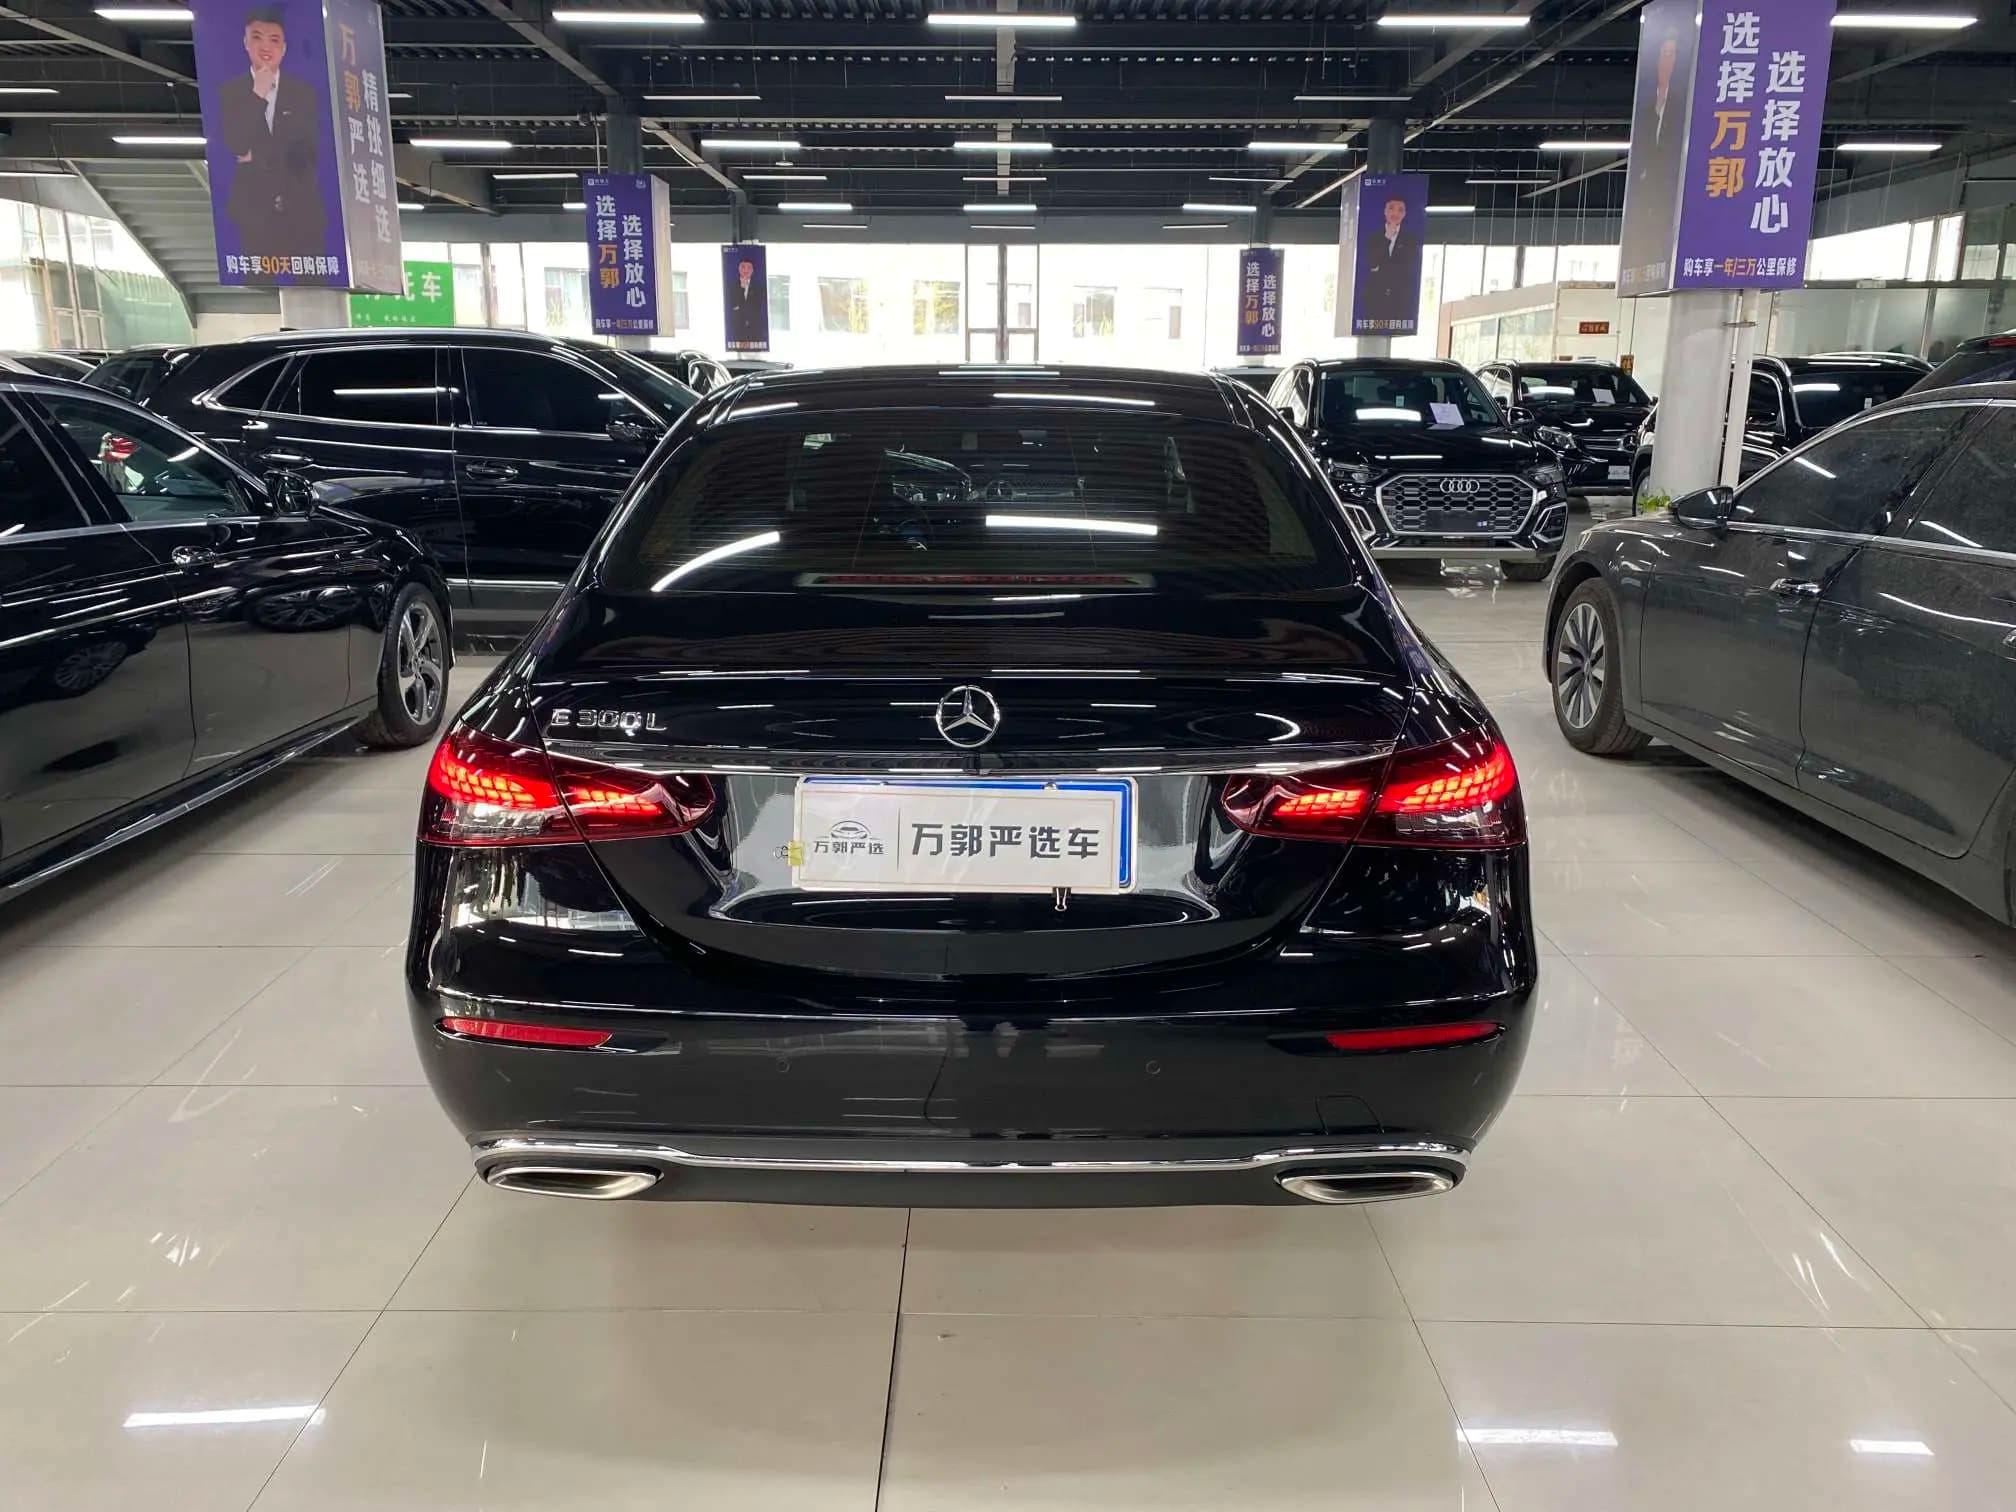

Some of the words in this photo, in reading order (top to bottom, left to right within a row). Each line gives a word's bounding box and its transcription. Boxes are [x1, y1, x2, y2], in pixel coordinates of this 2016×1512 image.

[337, 23, 371, 203] 万郭严选
[1705, 11, 1760, 198] 选择万郭
[361, 69, 392, 242] 精挑细选
[1750, 50, 1806, 234] 选择放心
[226, 255, 340, 276] 购车享90天回购保障
[595, 195, 621, 289] 选择万郭
[621, 214, 647, 308] 选择放心
[1683, 257, 1797, 277] 购车享一年/三万公里保修
[1245, 262, 1260, 324] 选择万郭
[1261, 274, 1277, 338] 选择放心
[551, 708, 572, 726] E
[646, 712, 668, 731] L
[813, 840, 885, 855] 万郭严选
[911, 823, 1101, 859] 万郭严选车
